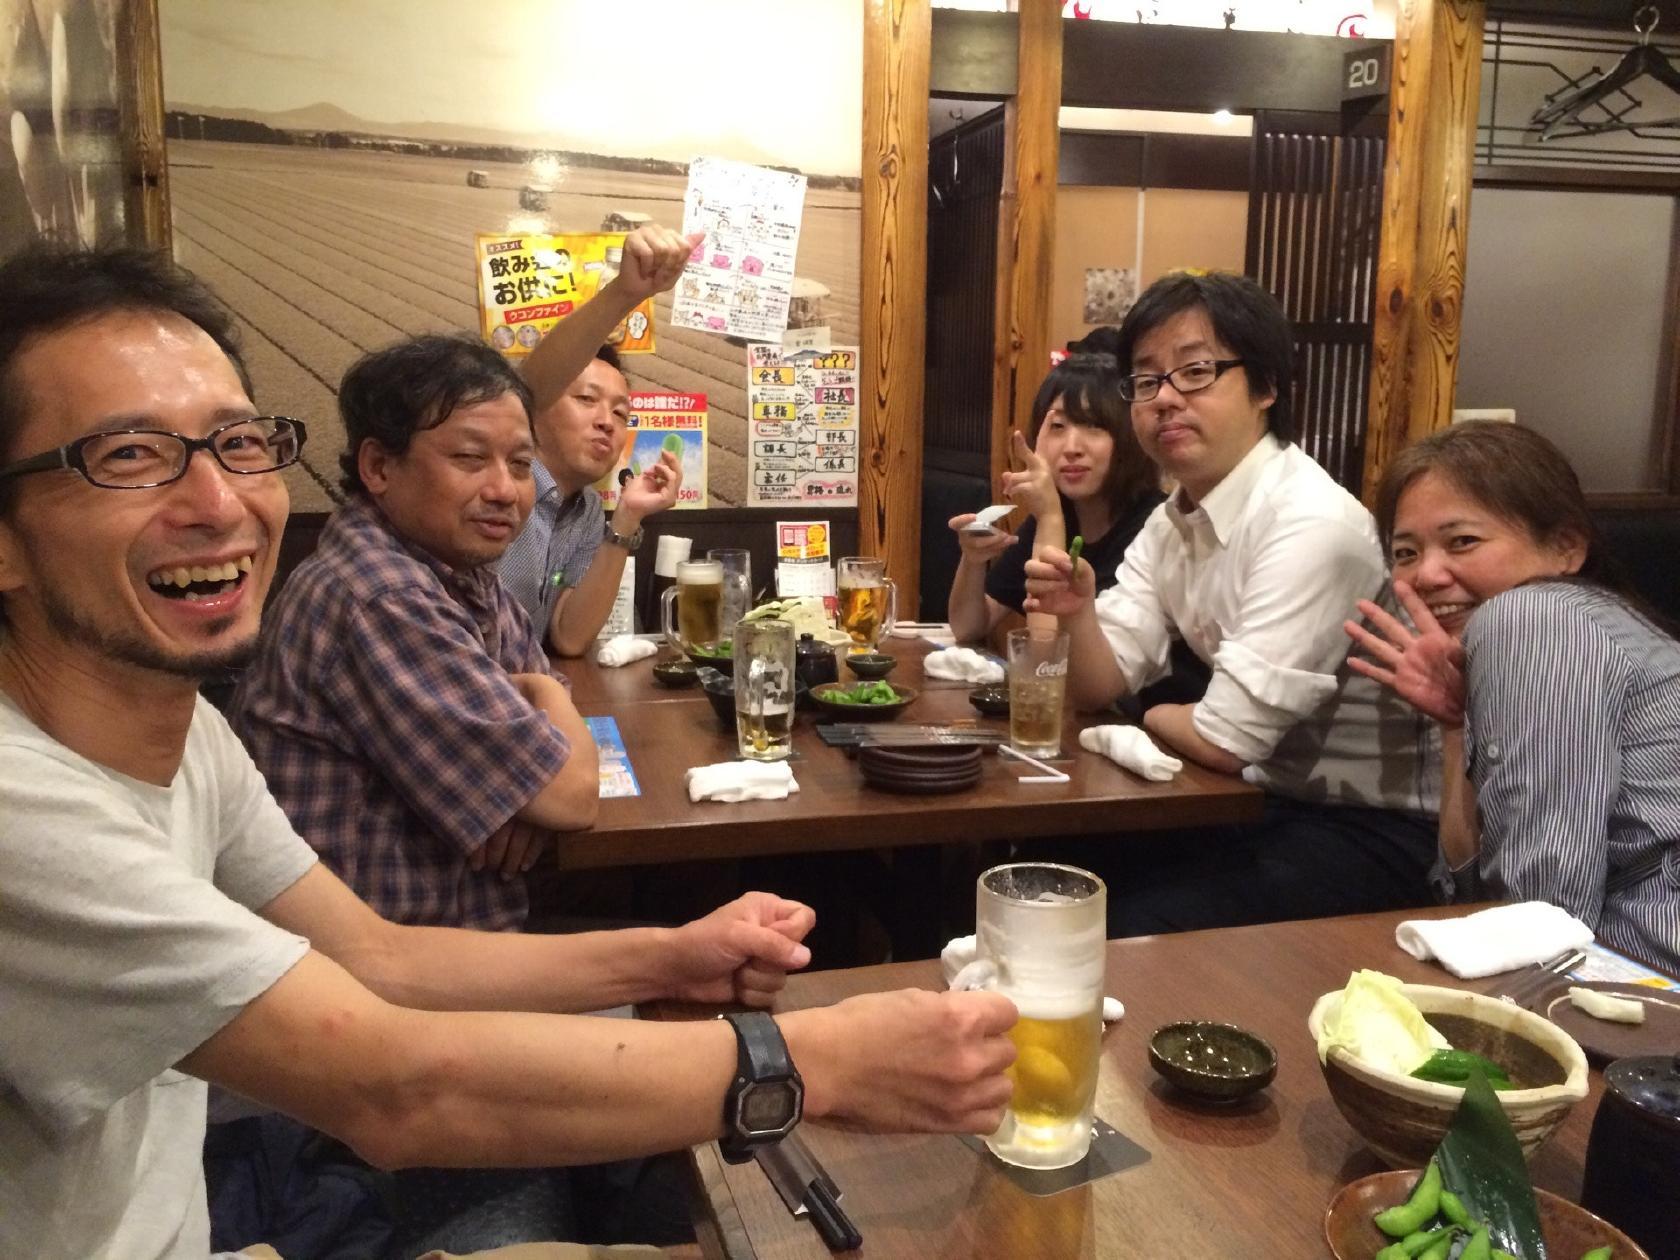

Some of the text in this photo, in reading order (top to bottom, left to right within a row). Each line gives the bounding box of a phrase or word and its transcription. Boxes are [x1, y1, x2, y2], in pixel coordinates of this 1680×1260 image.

[1348, 58, 1379, 89] 20
[510, 303, 570, 321] ウコンファイン
[759, 369, 784, 383] 会長
[823, 387, 849, 403] 社長
